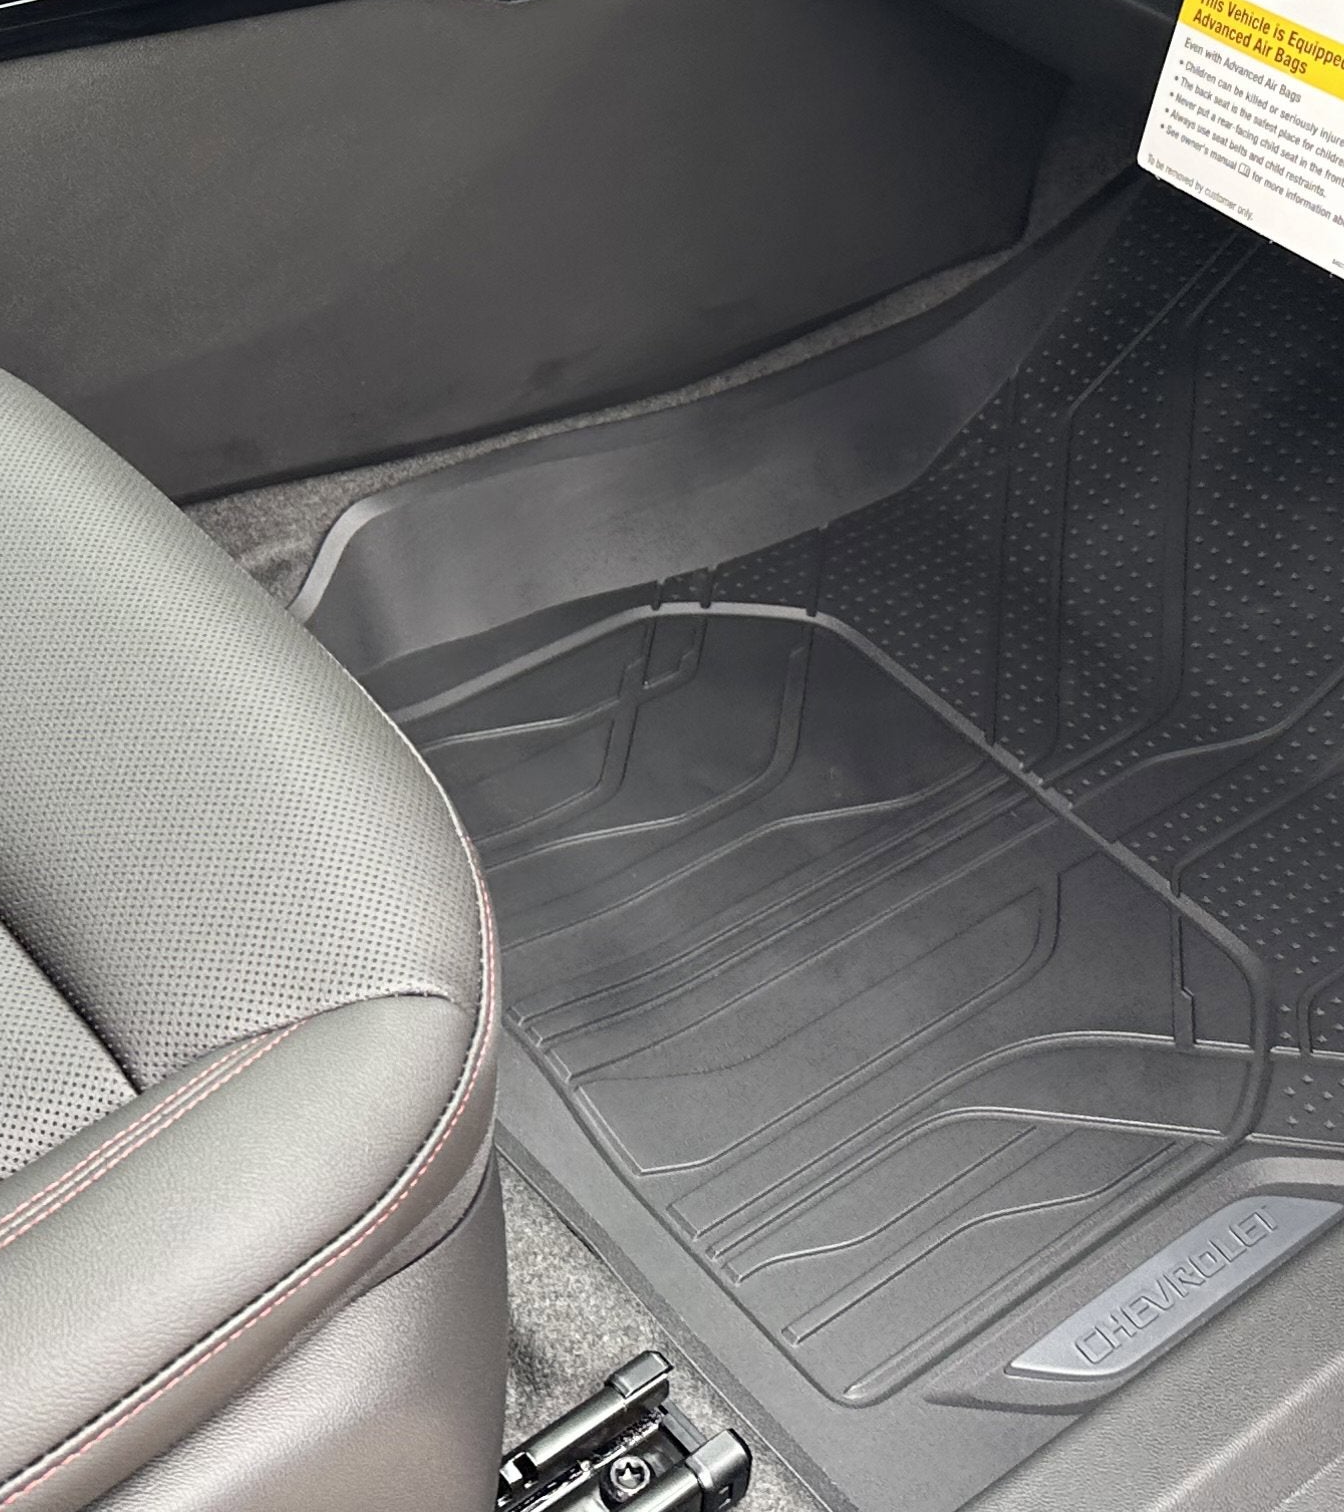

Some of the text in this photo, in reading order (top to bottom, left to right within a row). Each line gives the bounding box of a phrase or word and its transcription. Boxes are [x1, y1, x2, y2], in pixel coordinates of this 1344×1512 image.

[1193, 8, 1307, 74] Advanced Air Bags
[1228, 1, 1270, 35] Vehicle
[1273, 24, 1285, 42] is
[1184, 37, 1301, 103] Even with Advanced Air Bags
[1185, 61, 1216, 84] Children
[1218, 79, 1232, 92] can
[1234, 85, 1244, 97] be
[1245, 91, 1268, 110] killed
[1269, 105, 1279, 114] or
[1280, 110, 1318, 136] seriously
[1175, 93, 1197, 111] Never
[1197, 106, 1210, 118] put
[1211, 114, 1216, 122] a
[1217, 117, 1259, 146] rear-facing
[1260, 139, 1280, 154] child
[1280, 149, 1299, 164] seat
[1299, 157, 1308, 169] in
[1309, 162, 1323, 176] the
[1181, 76, 1194, 91] The
[1195, 84, 1213, 101] back
[1213, 96, 1230, 110] seat
[1231, 104, 1238, 114] is
[1240, 107, 1252, 121] the
[1253, 116, 1277, 134] safest
[1277, 129, 1300, 145] place
[1302, 139, 1314, 152] for
[1166, 125, 1179, 139] See
[1180, 135, 1209, 155] owner's
[1210, 150, 1237, 170] manual
[1252, 171, 1263, 184] for
[1264, 179, 1284, 195] more
[1285, 188, 1331, 220] information
[1170, 109, 1326, 198] Always use seat belts and child restraints.
[1074, 1205, 1278, 1365] CHEVROLET
